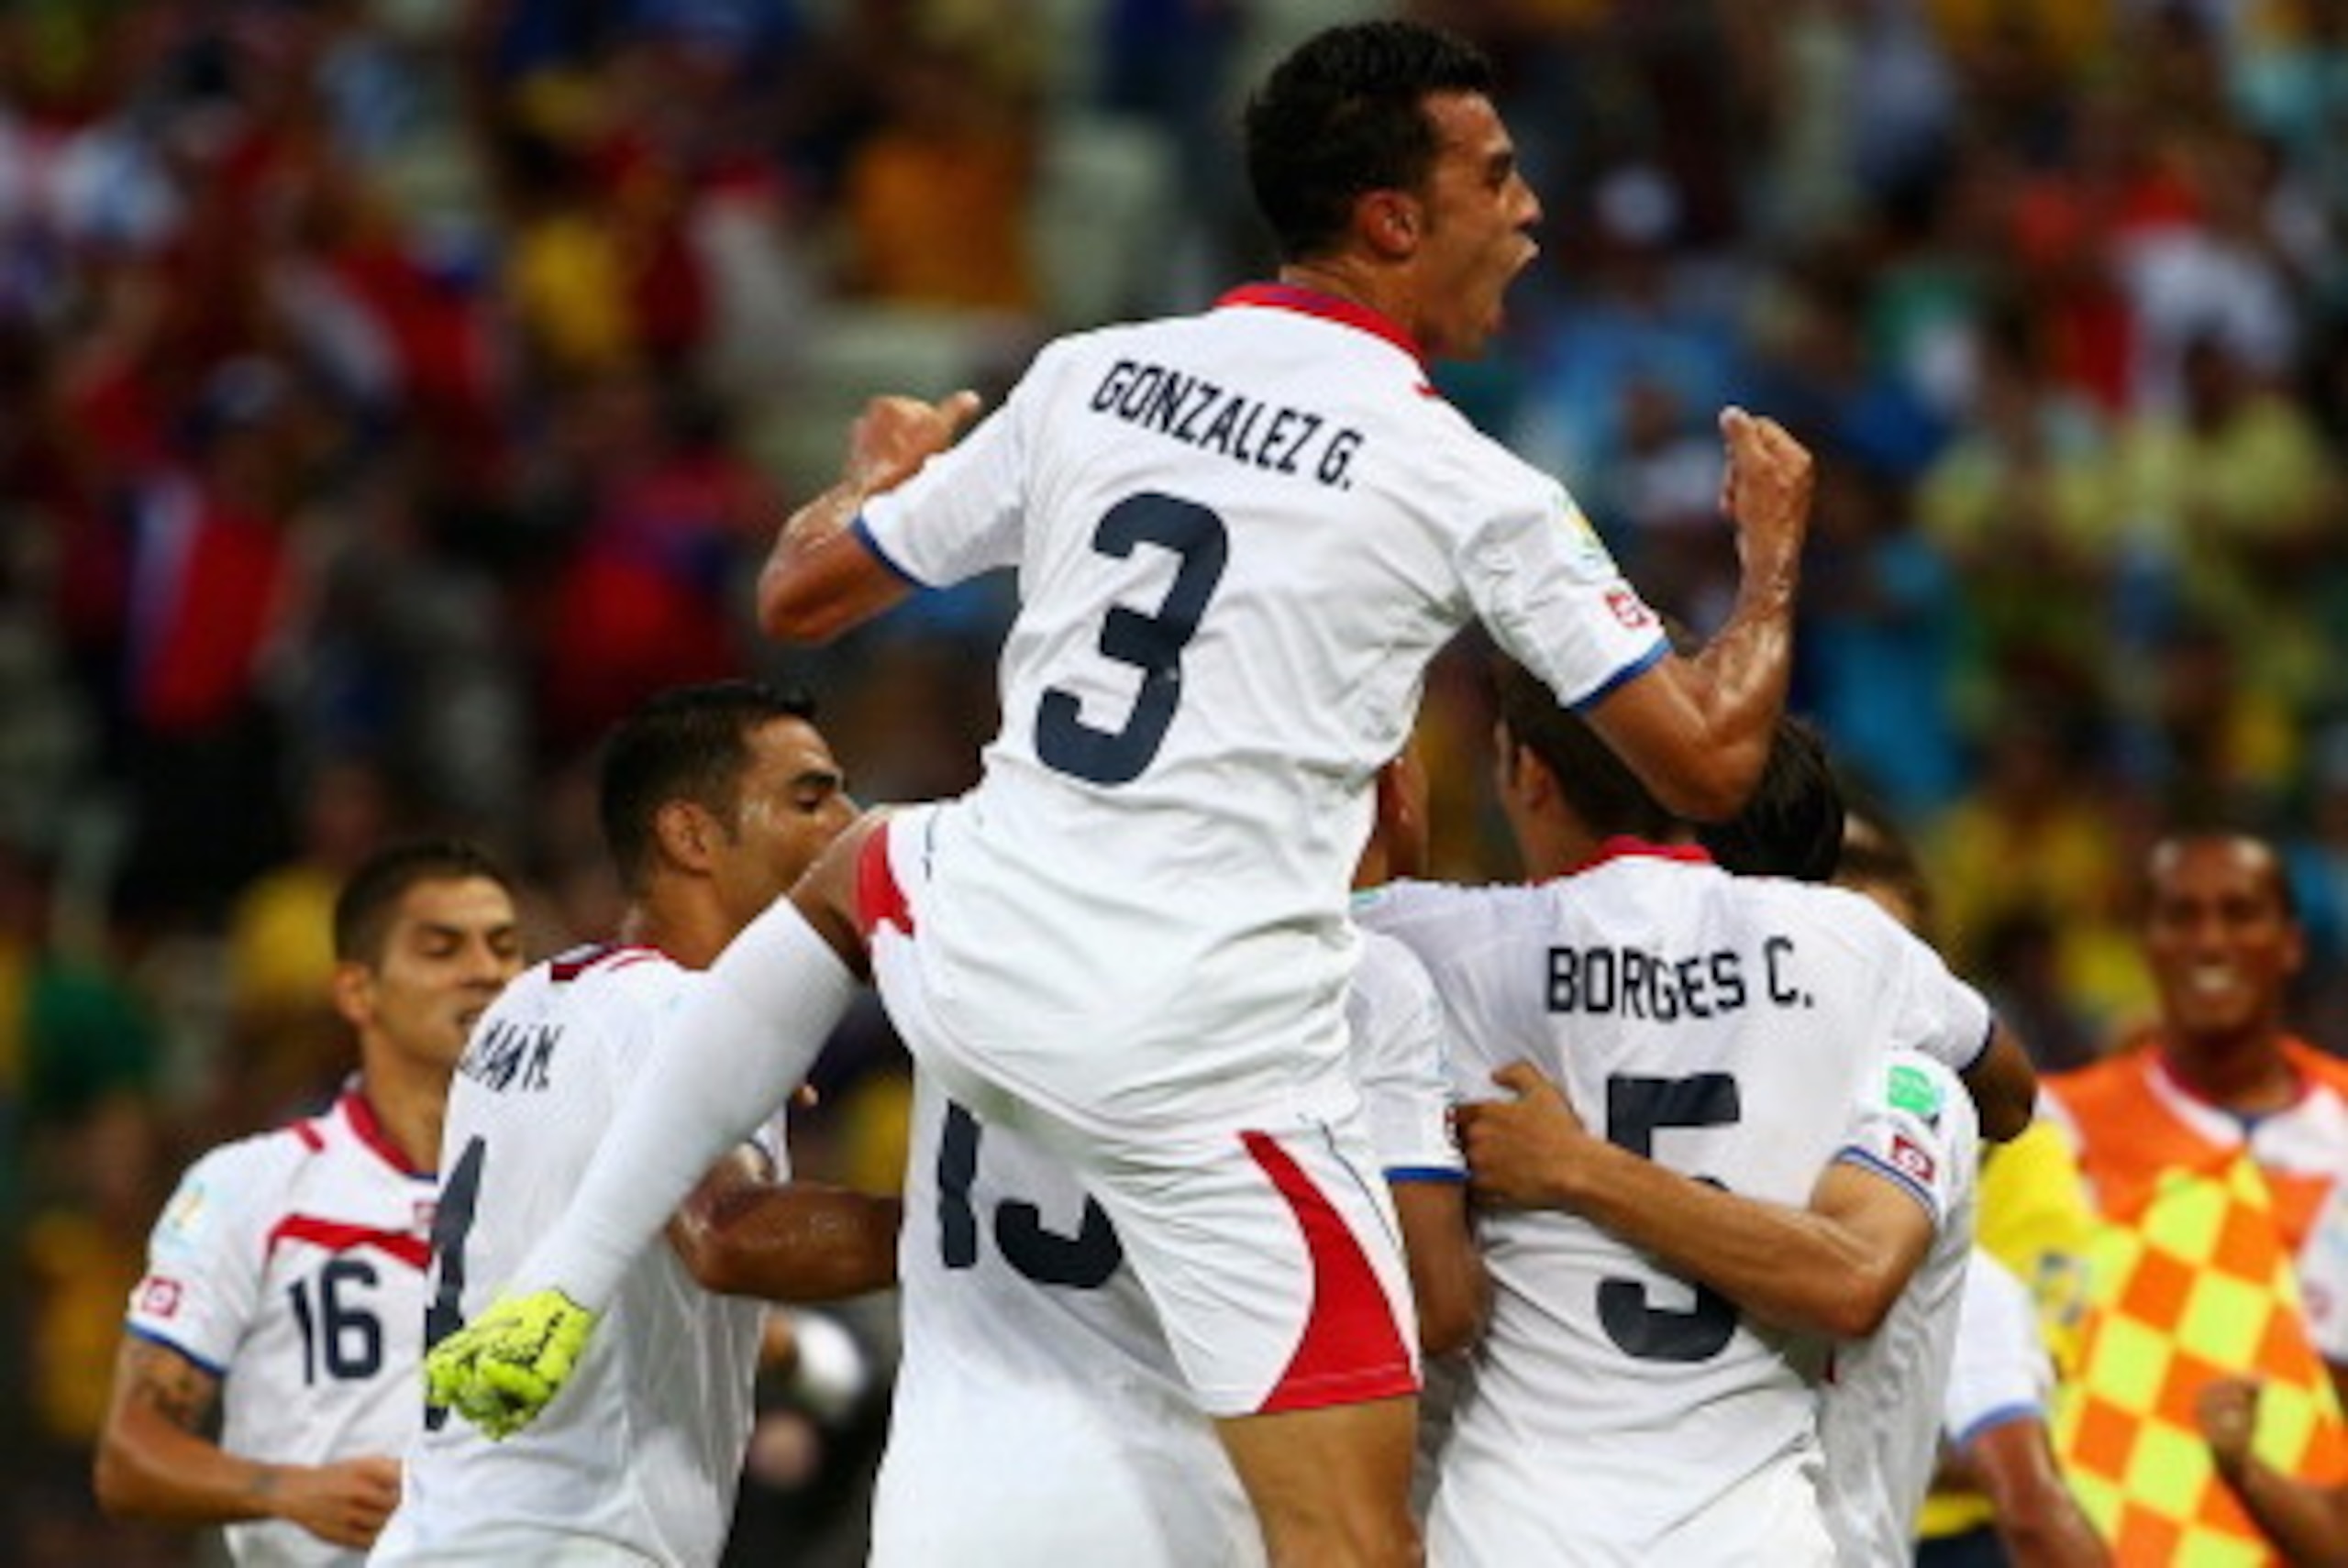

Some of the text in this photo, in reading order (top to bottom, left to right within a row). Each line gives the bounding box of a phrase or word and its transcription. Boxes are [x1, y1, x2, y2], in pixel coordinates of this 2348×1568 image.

[1090, 359, 1365, 490] GONZALEZ G.
[1034, 491, 1230, 788] 3
[1544, 935, 1815, 1023] BORGES C.
[1596, 1071, 1742, 1364] 5
[287, 1258, 383, 1386] 16
